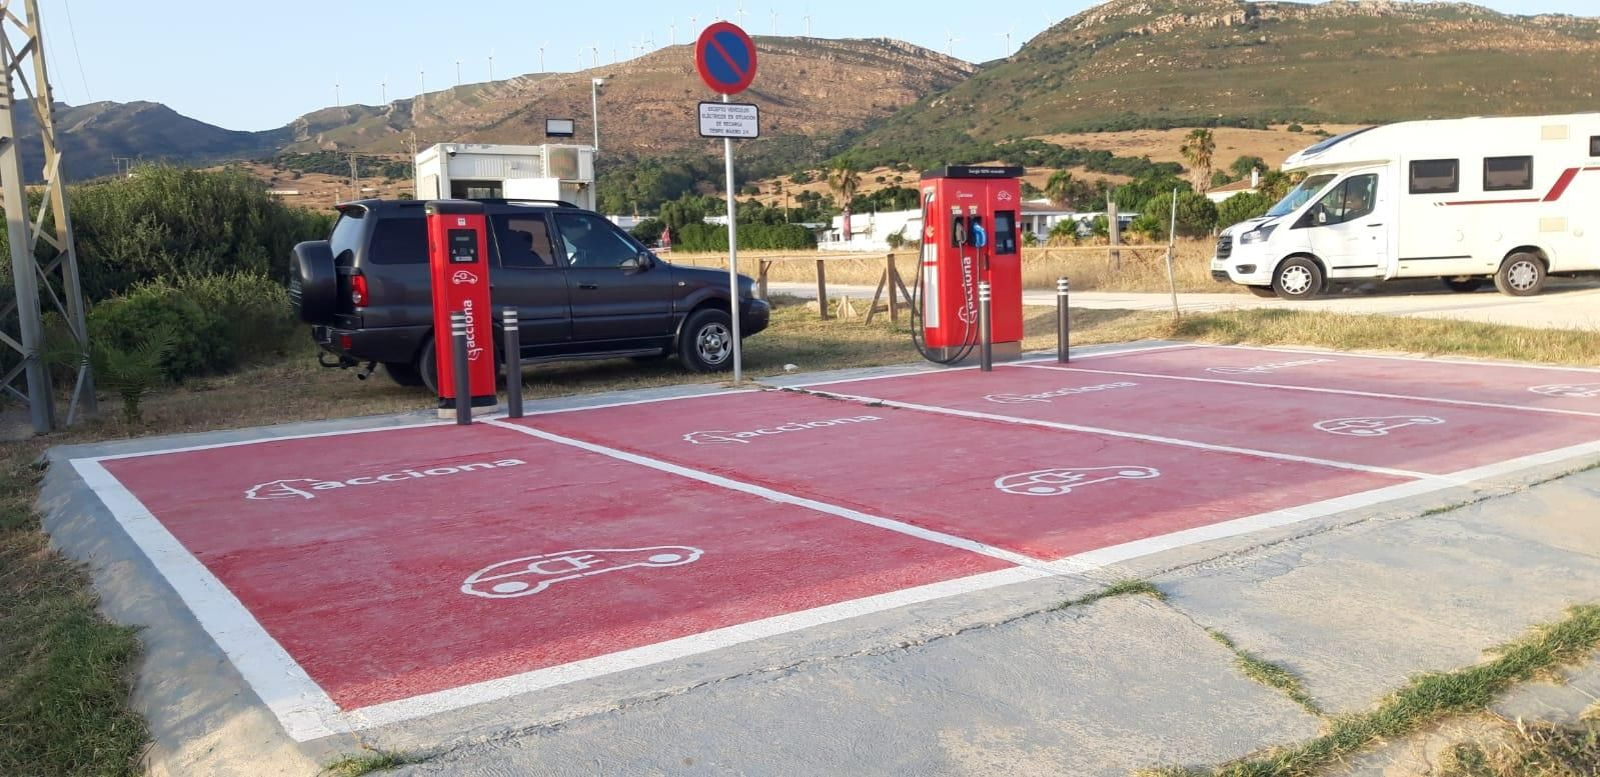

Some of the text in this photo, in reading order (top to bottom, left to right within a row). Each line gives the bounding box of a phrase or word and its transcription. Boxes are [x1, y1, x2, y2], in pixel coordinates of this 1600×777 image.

[962, 256, 974, 310] acciona
[463, 299, 475, 348] acciona
[731, 415, 884, 439] acciona
[311, 457, 527, 490] acciona
